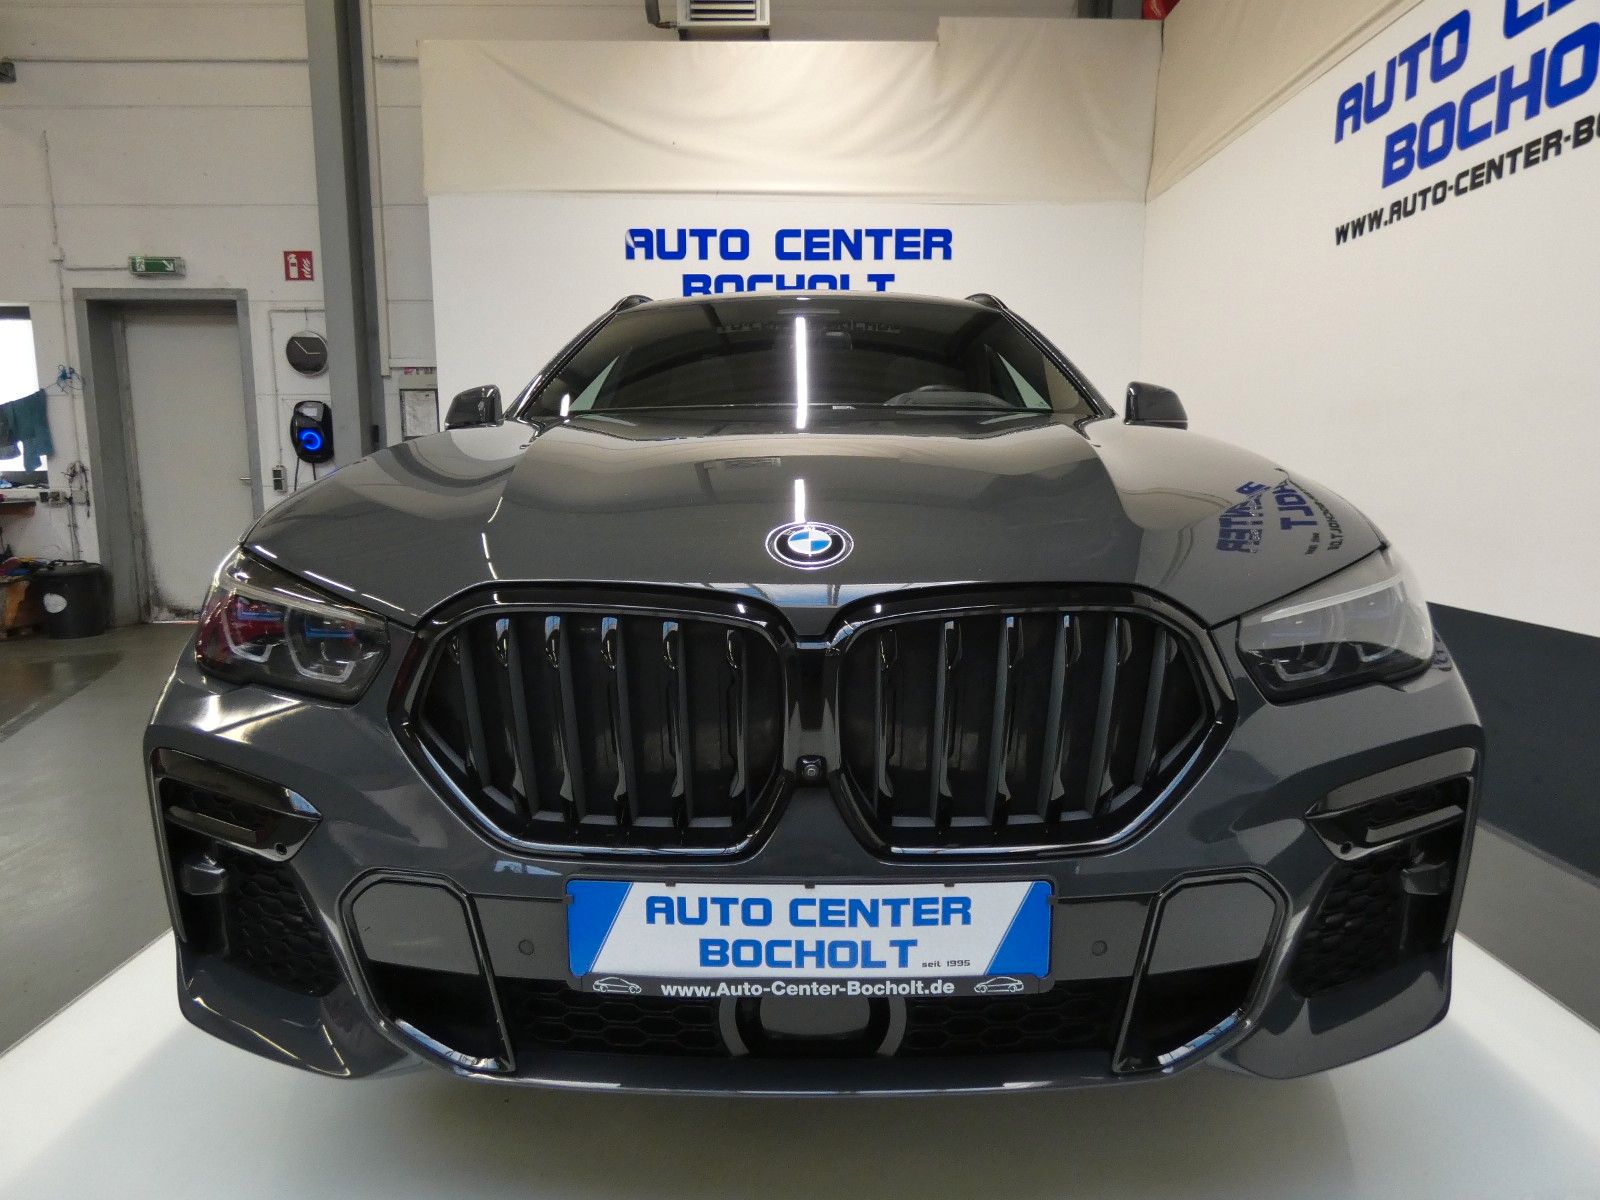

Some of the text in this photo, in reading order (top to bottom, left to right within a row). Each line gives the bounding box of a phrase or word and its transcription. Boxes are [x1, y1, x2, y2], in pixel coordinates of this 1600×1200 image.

[1335, 9, 1470, 144] AUTO
[1335, 112, 1600, 246] WWW.AUTO-CENTER-B
[625, 228, 952, 260] AUTO CENTER
[645, 895, 971, 927] AUTO CENTER
[699, 938, 918, 969] BOCHOLT
[921, 959, 971, 968] seit 1995
[660, 979, 955, 997] www.Auto-Center-Bocholt.de
